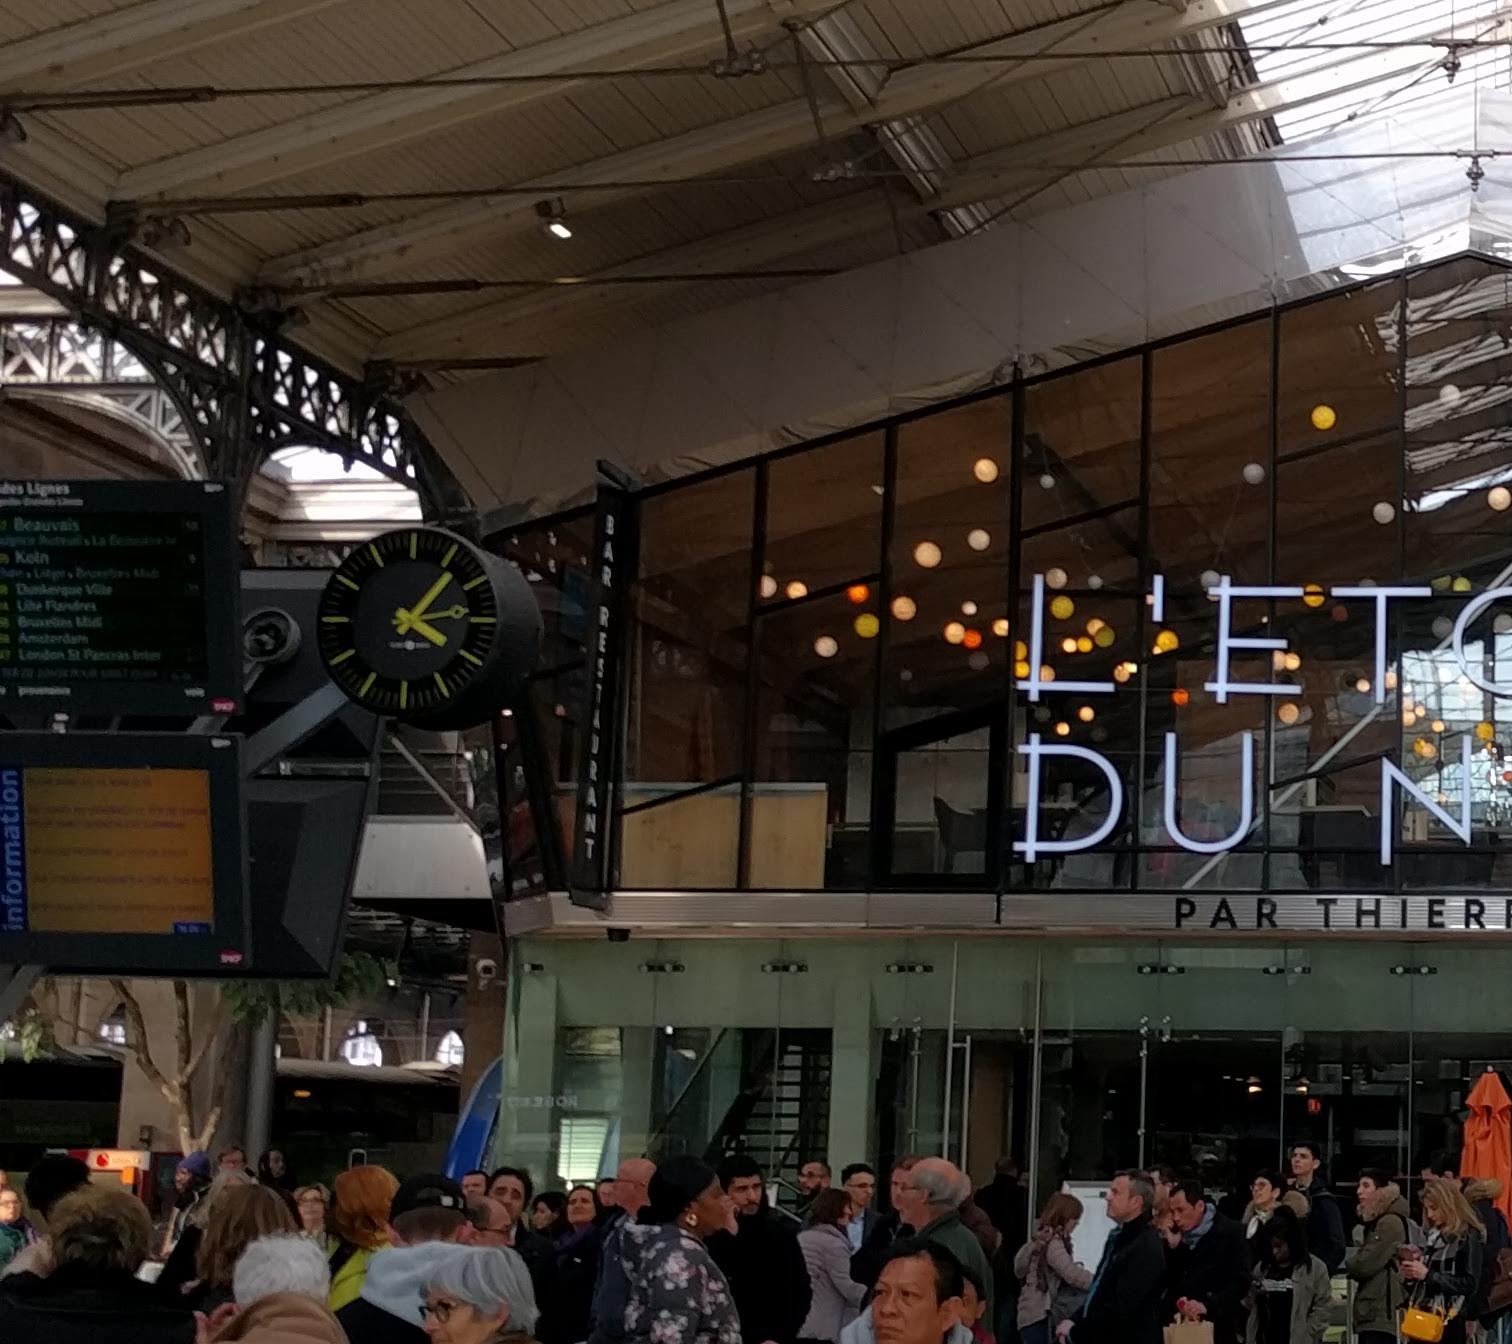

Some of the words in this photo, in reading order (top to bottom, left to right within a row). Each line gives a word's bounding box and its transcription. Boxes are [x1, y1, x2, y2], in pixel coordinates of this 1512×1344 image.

[26, 482, 71, 497] Lignes
[14, 517, 80, 532] Beauvais
[601, 514, 615, 587] BAR
[19, 648, 65, 661] London
[584, 605, 609, 860] RESTAURANT
[1013, 732, 1254, 864] DU
[1, 769, 24, 931] information
[1174, 898, 1279, 929] PAR
